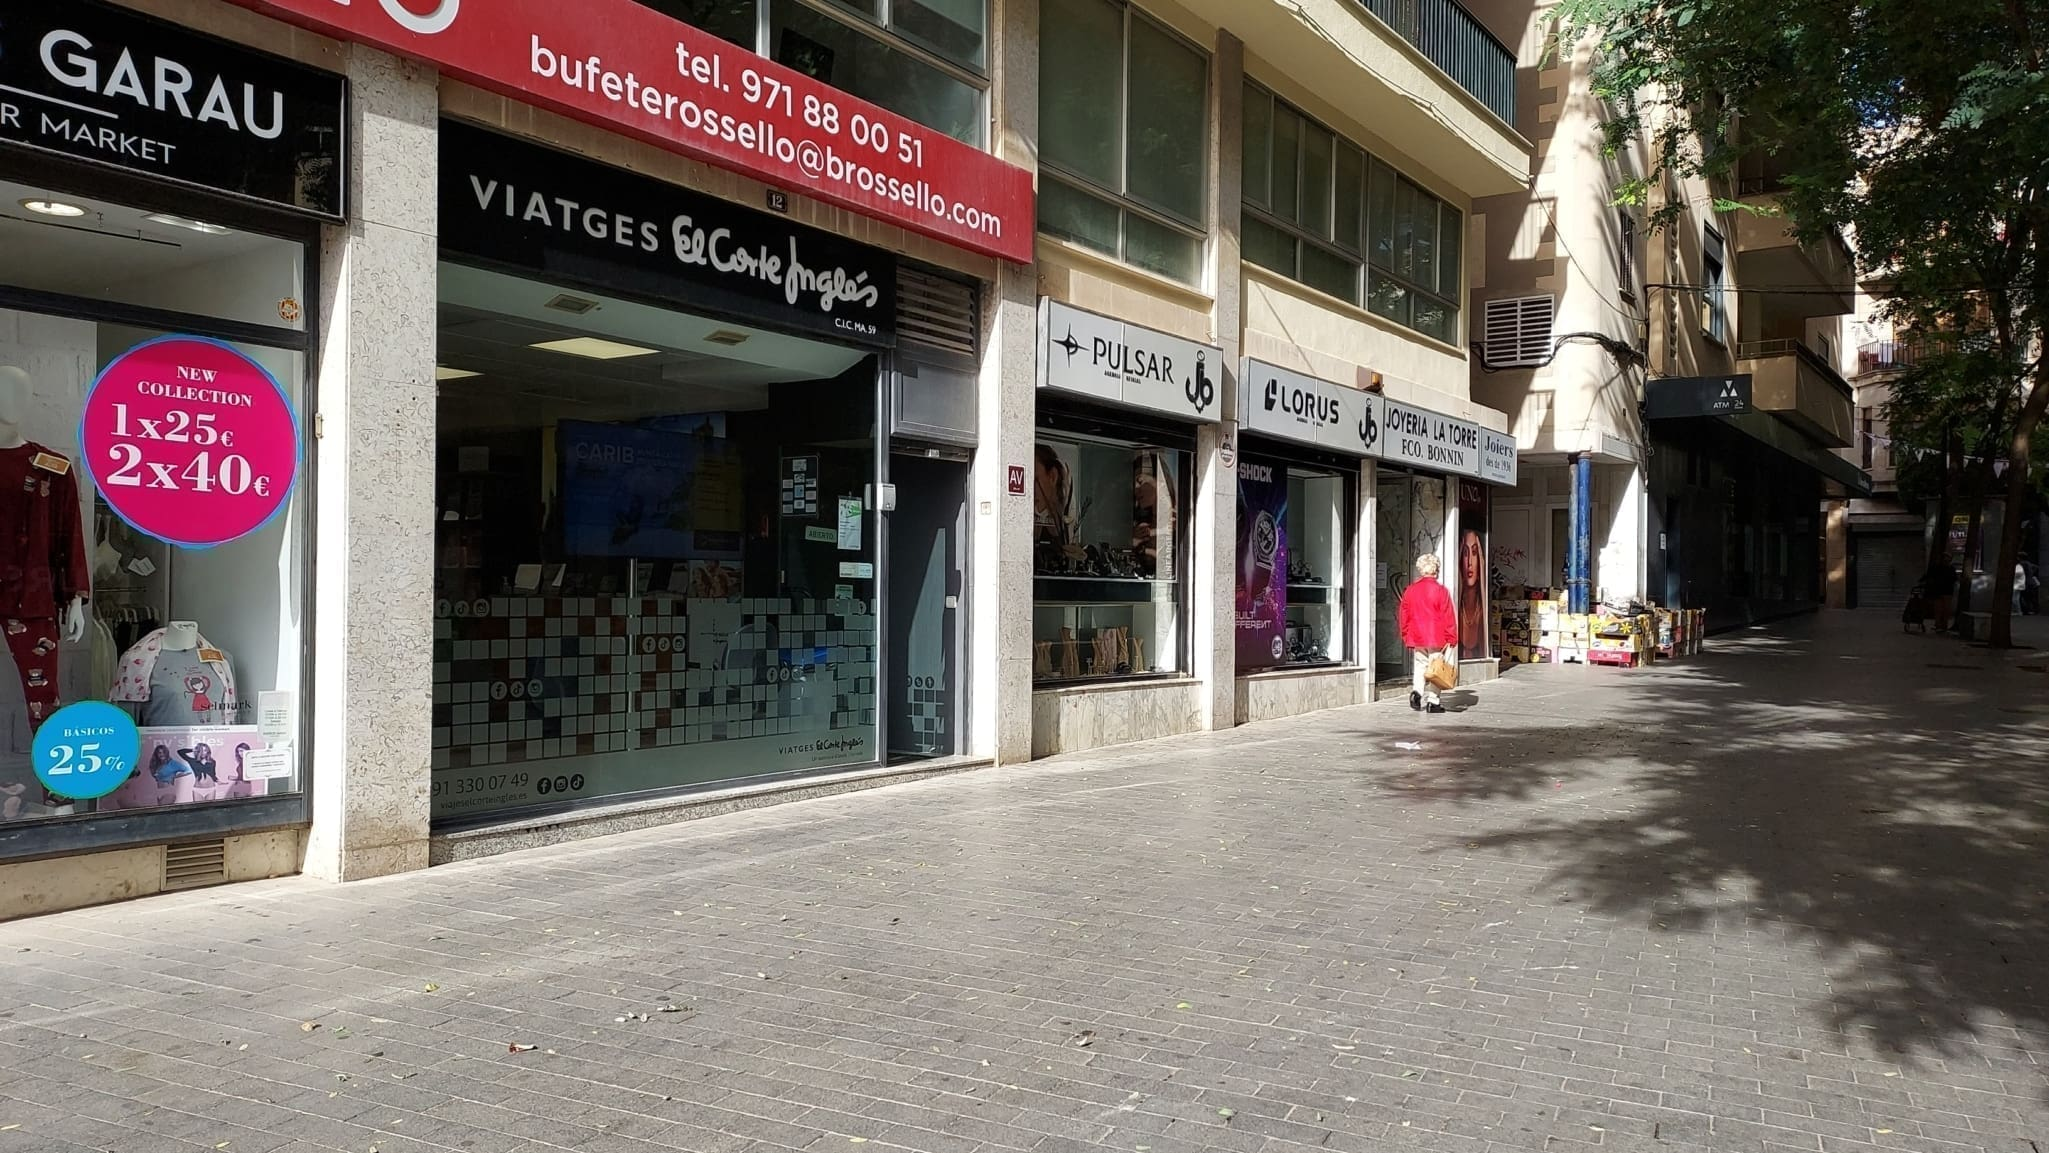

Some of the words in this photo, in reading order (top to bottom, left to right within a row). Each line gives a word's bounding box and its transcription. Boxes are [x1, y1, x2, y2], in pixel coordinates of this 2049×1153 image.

[40, 29, 283, 139] GARAU
[676, 42, 730, 92] tel.
[741, 69, 792, 116] 971
[804, 95, 839, 134] 88
[851, 115, 888, 153] 00
[899, 133, 923, 168] 51
[41, 113, 176, 165] MARKET
[531, 34, 1001, 238] bufeterossello@brossello.com
[771, 193, 783, 208] 12
[470, 175, 659, 252] VIATGES
[671, 214, 706, 264] El
[709, 228, 782, 285] Corte
[785, 235, 878, 312] Inglés
[1093, 337, 1174, 384] PULSAR
[176, 365, 217, 383] NEW
[138, 381, 252, 407] COLLECTION
[1282, 385, 1339, 424] LORUS
[1713, 401, 1730, 409] ATM
[1734, 399, 1744, 408] 24
[1386, 408, 1428, 438] JOYERIA
[1433, 421, 1445, 441] LA
[1449, 424, 1477, 450] TORRE
[1402, 438, 1424, 458] FCO.
[1428, 444, 1464, 467] BONNIN
[1484, 436, 1514, 458] Joiers
[1009, 469, 1023, 485] AV
[1237, 462, 1273, 483] -SHOCK
[808, 529, 834, 540] ABIERTO
[64, 726, 114, 737] BÁSICOS
[48, 742, 126, 775] 25%
[778, 743, 813, 755] VIATGES
[432, 780, 449, 797] 91
[455, 777, 484, 794] 330
[489, 774, 506, 790] 07
[510, 772, 529, 787] 49
